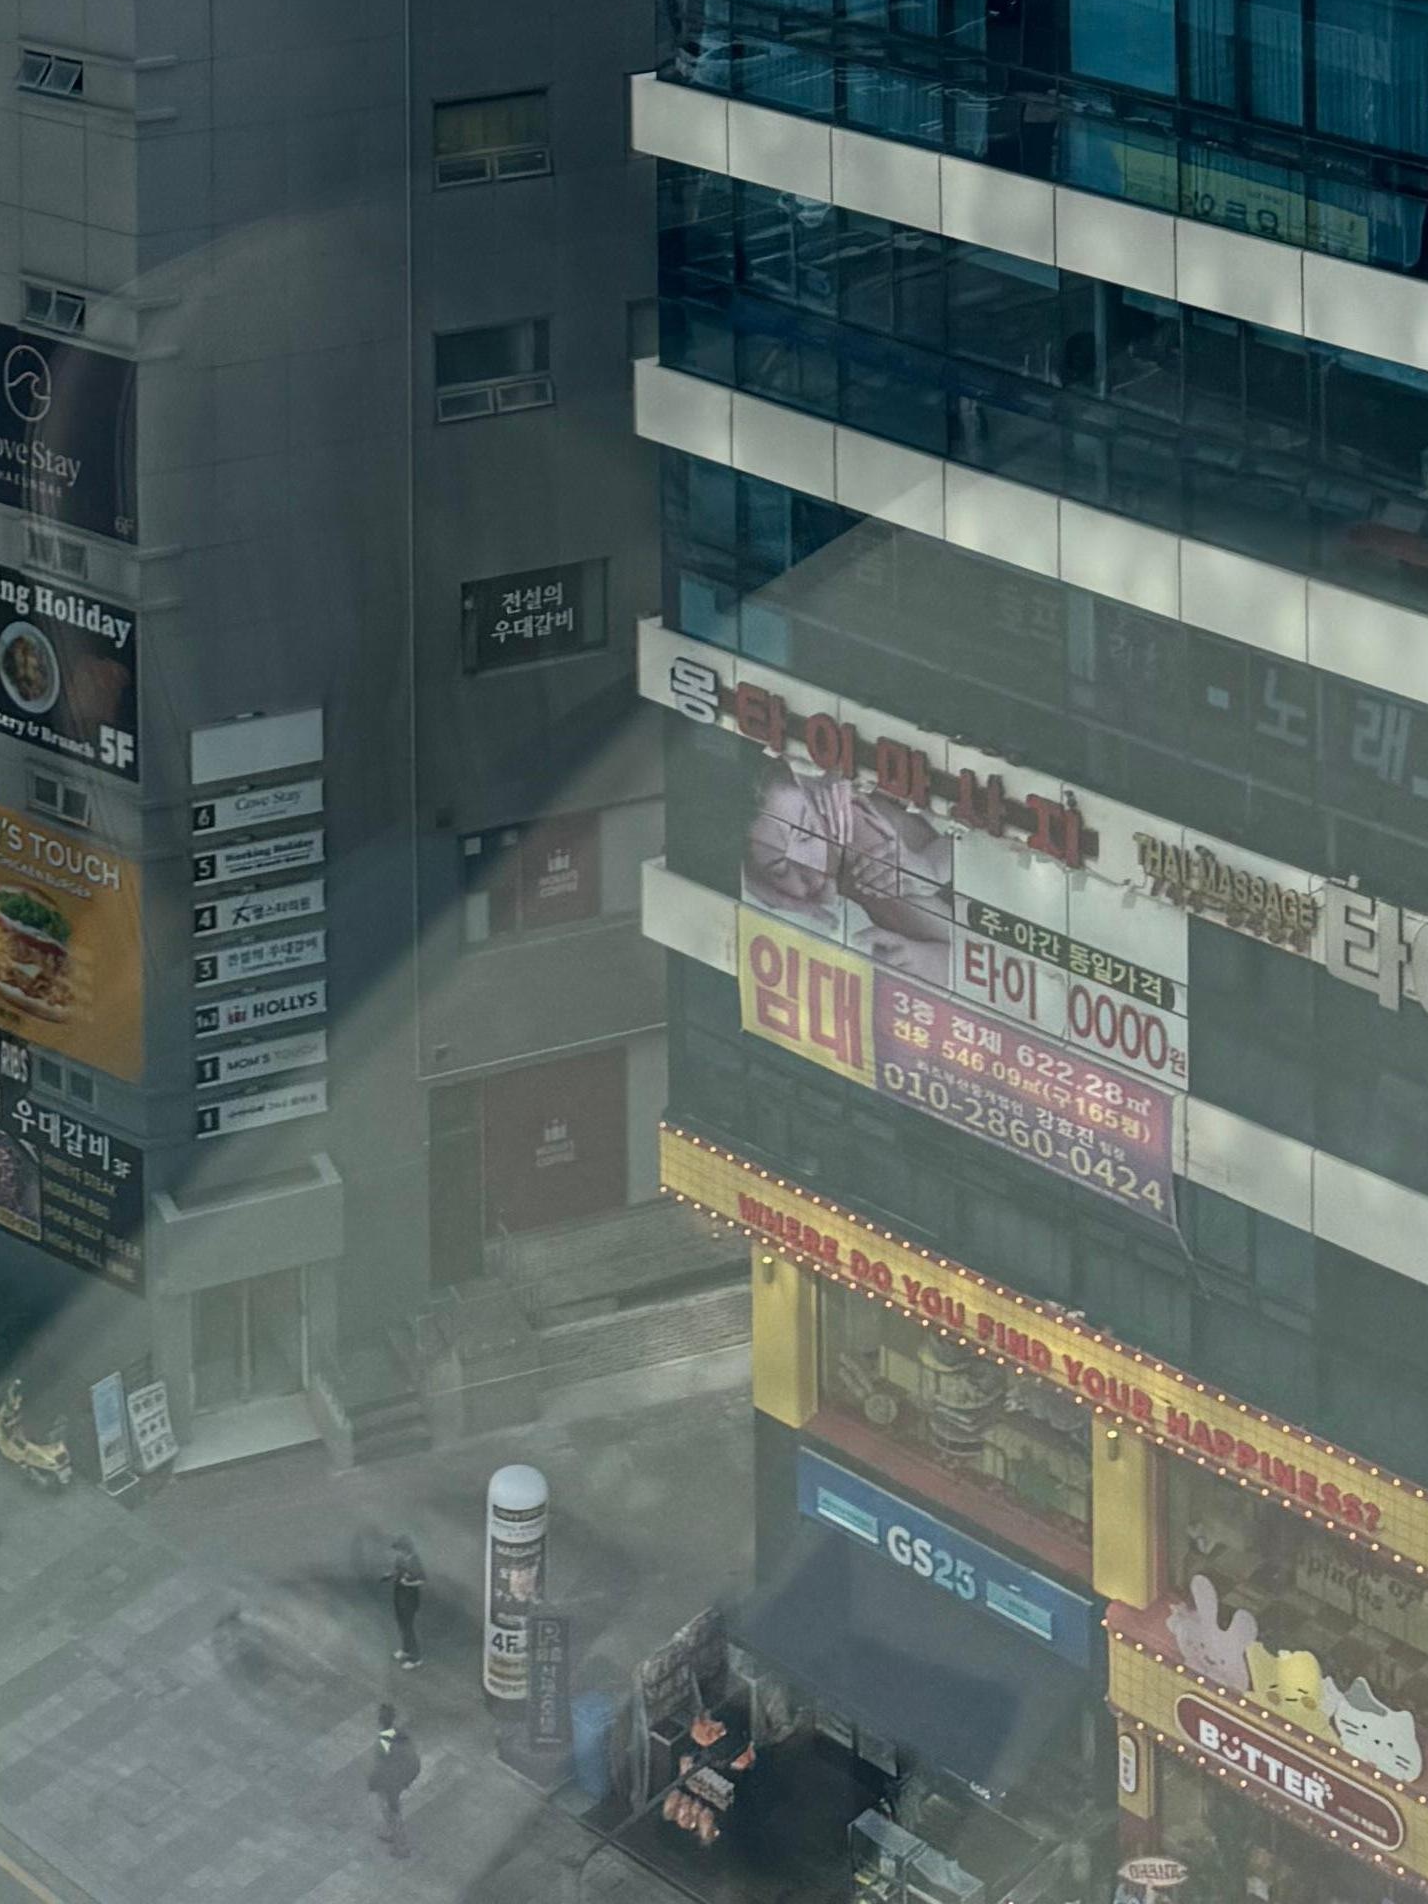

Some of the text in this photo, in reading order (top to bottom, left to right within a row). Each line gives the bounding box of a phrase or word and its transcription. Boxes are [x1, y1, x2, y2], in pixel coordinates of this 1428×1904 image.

[31, 440, 82, 486] Stay
[35, 584, 132, 649] Holiday
[501, 582, 563, 615] 전설의
[490, 607, 574, 644] 우대갈비
[99, 724, 134, 768] 5F
[198, 808, 210, 827] 6
[28, 832, 120, 891] TOUCH
[198, 859, 211, 877] 5
[1194, 844, 1319, 930] MASSAGE
[197, 910, 212, 928] 4
[199, 960, 212, 978] 3
[963, 939, 1038, 1022] 타이
[1068, 943, 1164, 1006] 동일가격
[253, 991, 318, 1019] HOLLYS
[749, 934, 865, 1071] 임대
[892, 991, 935, 1026] 3층
[951, 1015, 1002, 1056] 전체
[12, 1098, 110, 1171] 우대갈비
[883, 1061, 1164, 1211] 010-2860-0424
[1036, 1106, 1095, 1150] 강효진
[737, 1190, 1382, 1532] WHERE DO YOU FIND YOUR HAPPINESS?
[886, 1525, 977, 1600] GS25
[491, 1631, 521, 1654] 4F
